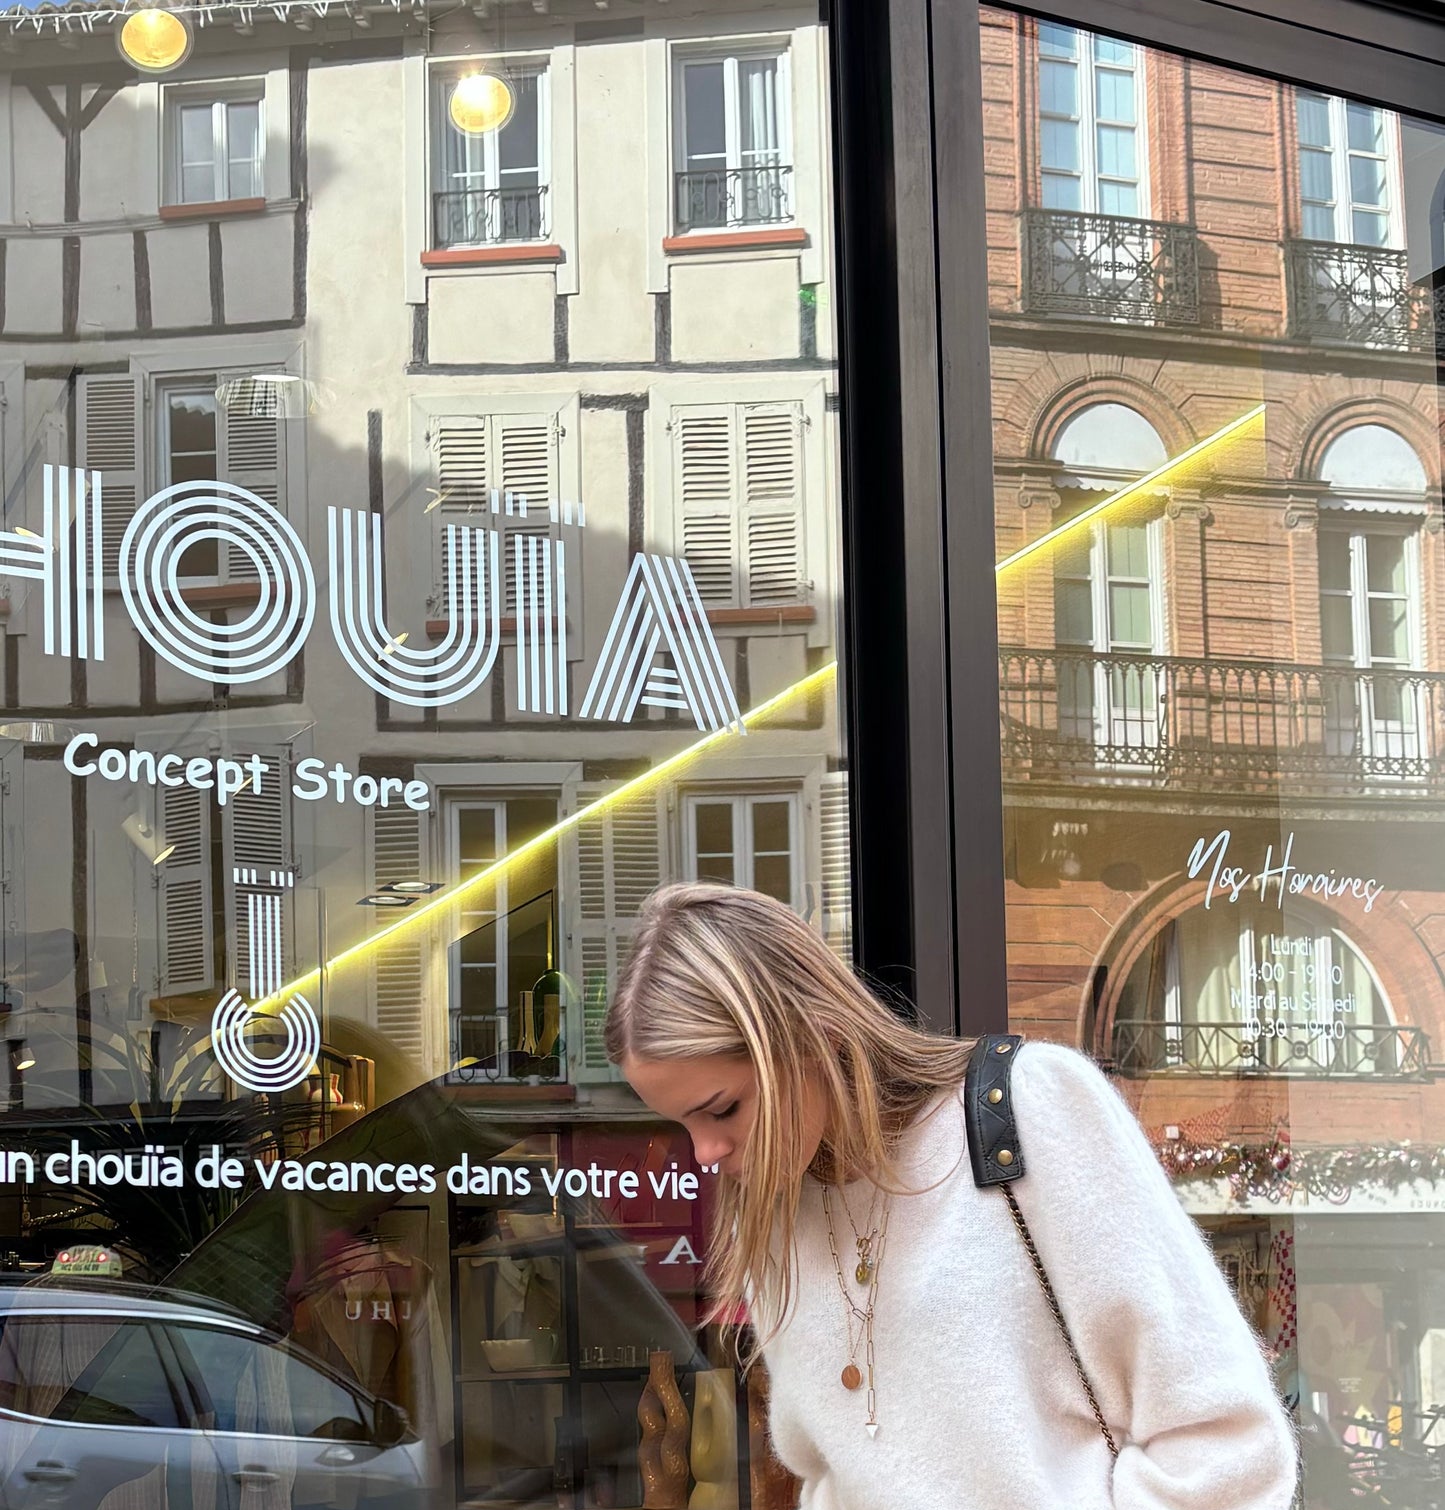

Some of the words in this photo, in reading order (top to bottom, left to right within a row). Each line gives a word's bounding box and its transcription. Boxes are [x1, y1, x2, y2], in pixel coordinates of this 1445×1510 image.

[63, 733, 269, 806] Concept
[292, 757, 431, 811] Store
[1187, 830, 1250, 910] Nos
[1253, 832, 1384, 912] Horaires
[1270, 933, 1312, 956] Lundi
[1279, 996, 1298, 1011] au
[45, 1139, 184, 1188] chouïa
[195, 1144, 245, 1189] de
[254, 1159, 437, 1194] vacances
[447, 1153, 532, 1196] dans
[540, 1162, 640, 1198] votre
